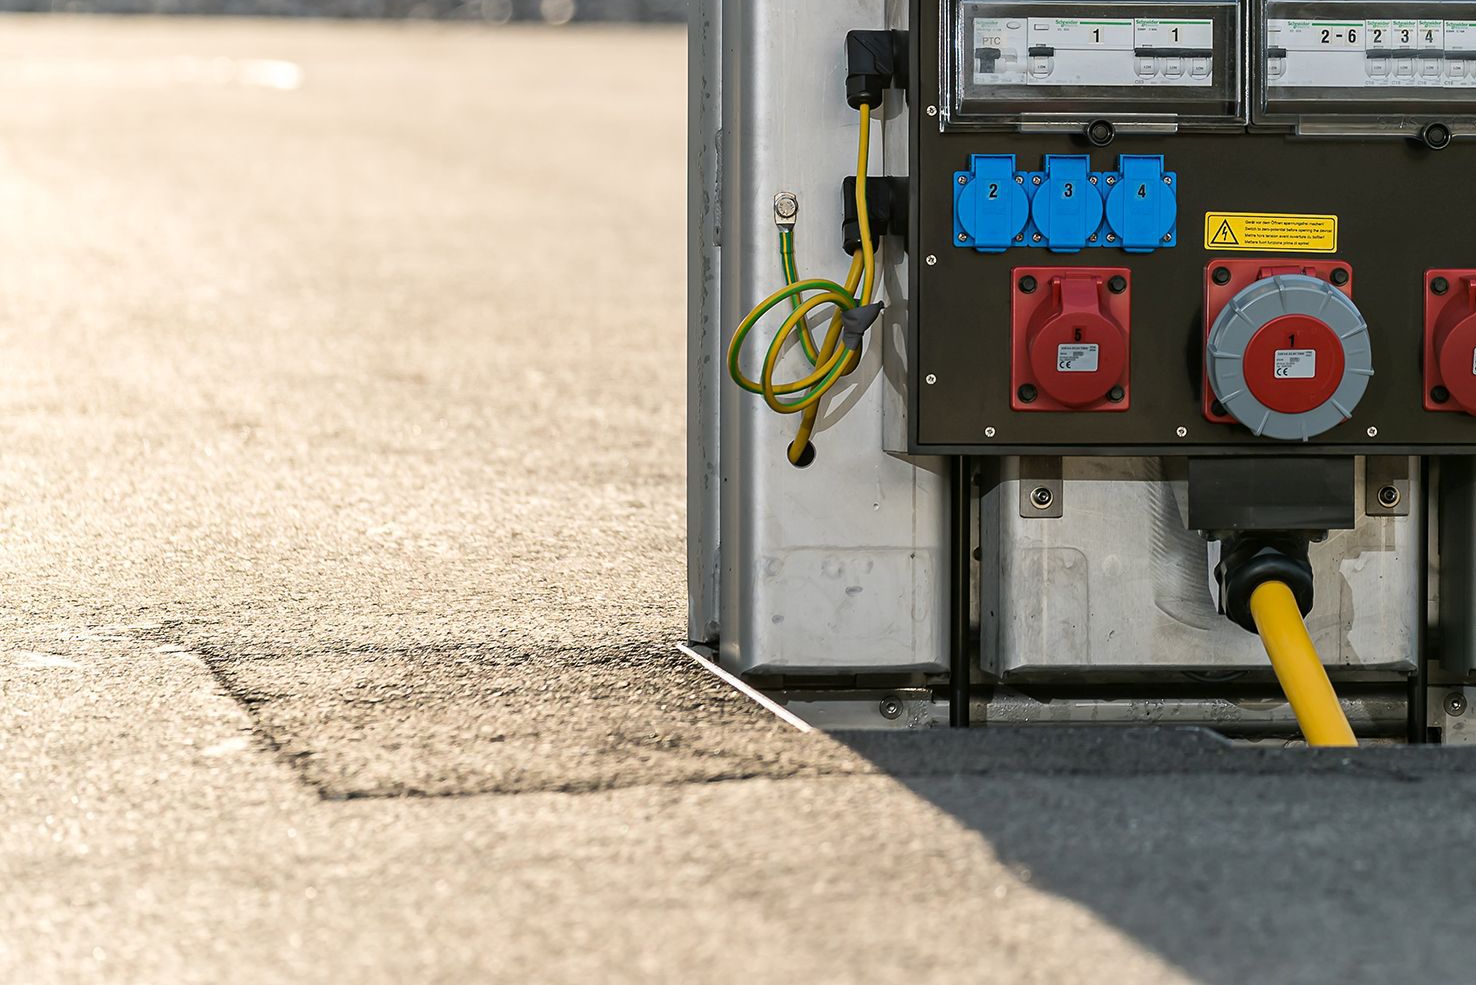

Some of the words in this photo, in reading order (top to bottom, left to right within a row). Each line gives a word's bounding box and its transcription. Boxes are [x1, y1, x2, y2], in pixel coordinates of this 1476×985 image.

[982, 36, 1001, 45] PTC
[1093, 28, 1099, 43] 1
[1171, 27, 1178, 42] 1
[1321, 29, 1330, 43] 2
[1348, 29, 1356, 43] 6
[1373, 29, 1382, 43] 2
[1401, 29, 1409, 43] 3
[1425, 29, 1434, 43] 4
[988, 183, 998, 198] 2
[1064, 183, 1073, 198] 3
[1137, 184, 1146, 198] 4
[1074, 328, 1082, 342] 5
[1288, 334, 1295, 347] 1
[1059, 361, 1071, 369] CE
[1276, 368, 1288, 376] CE
